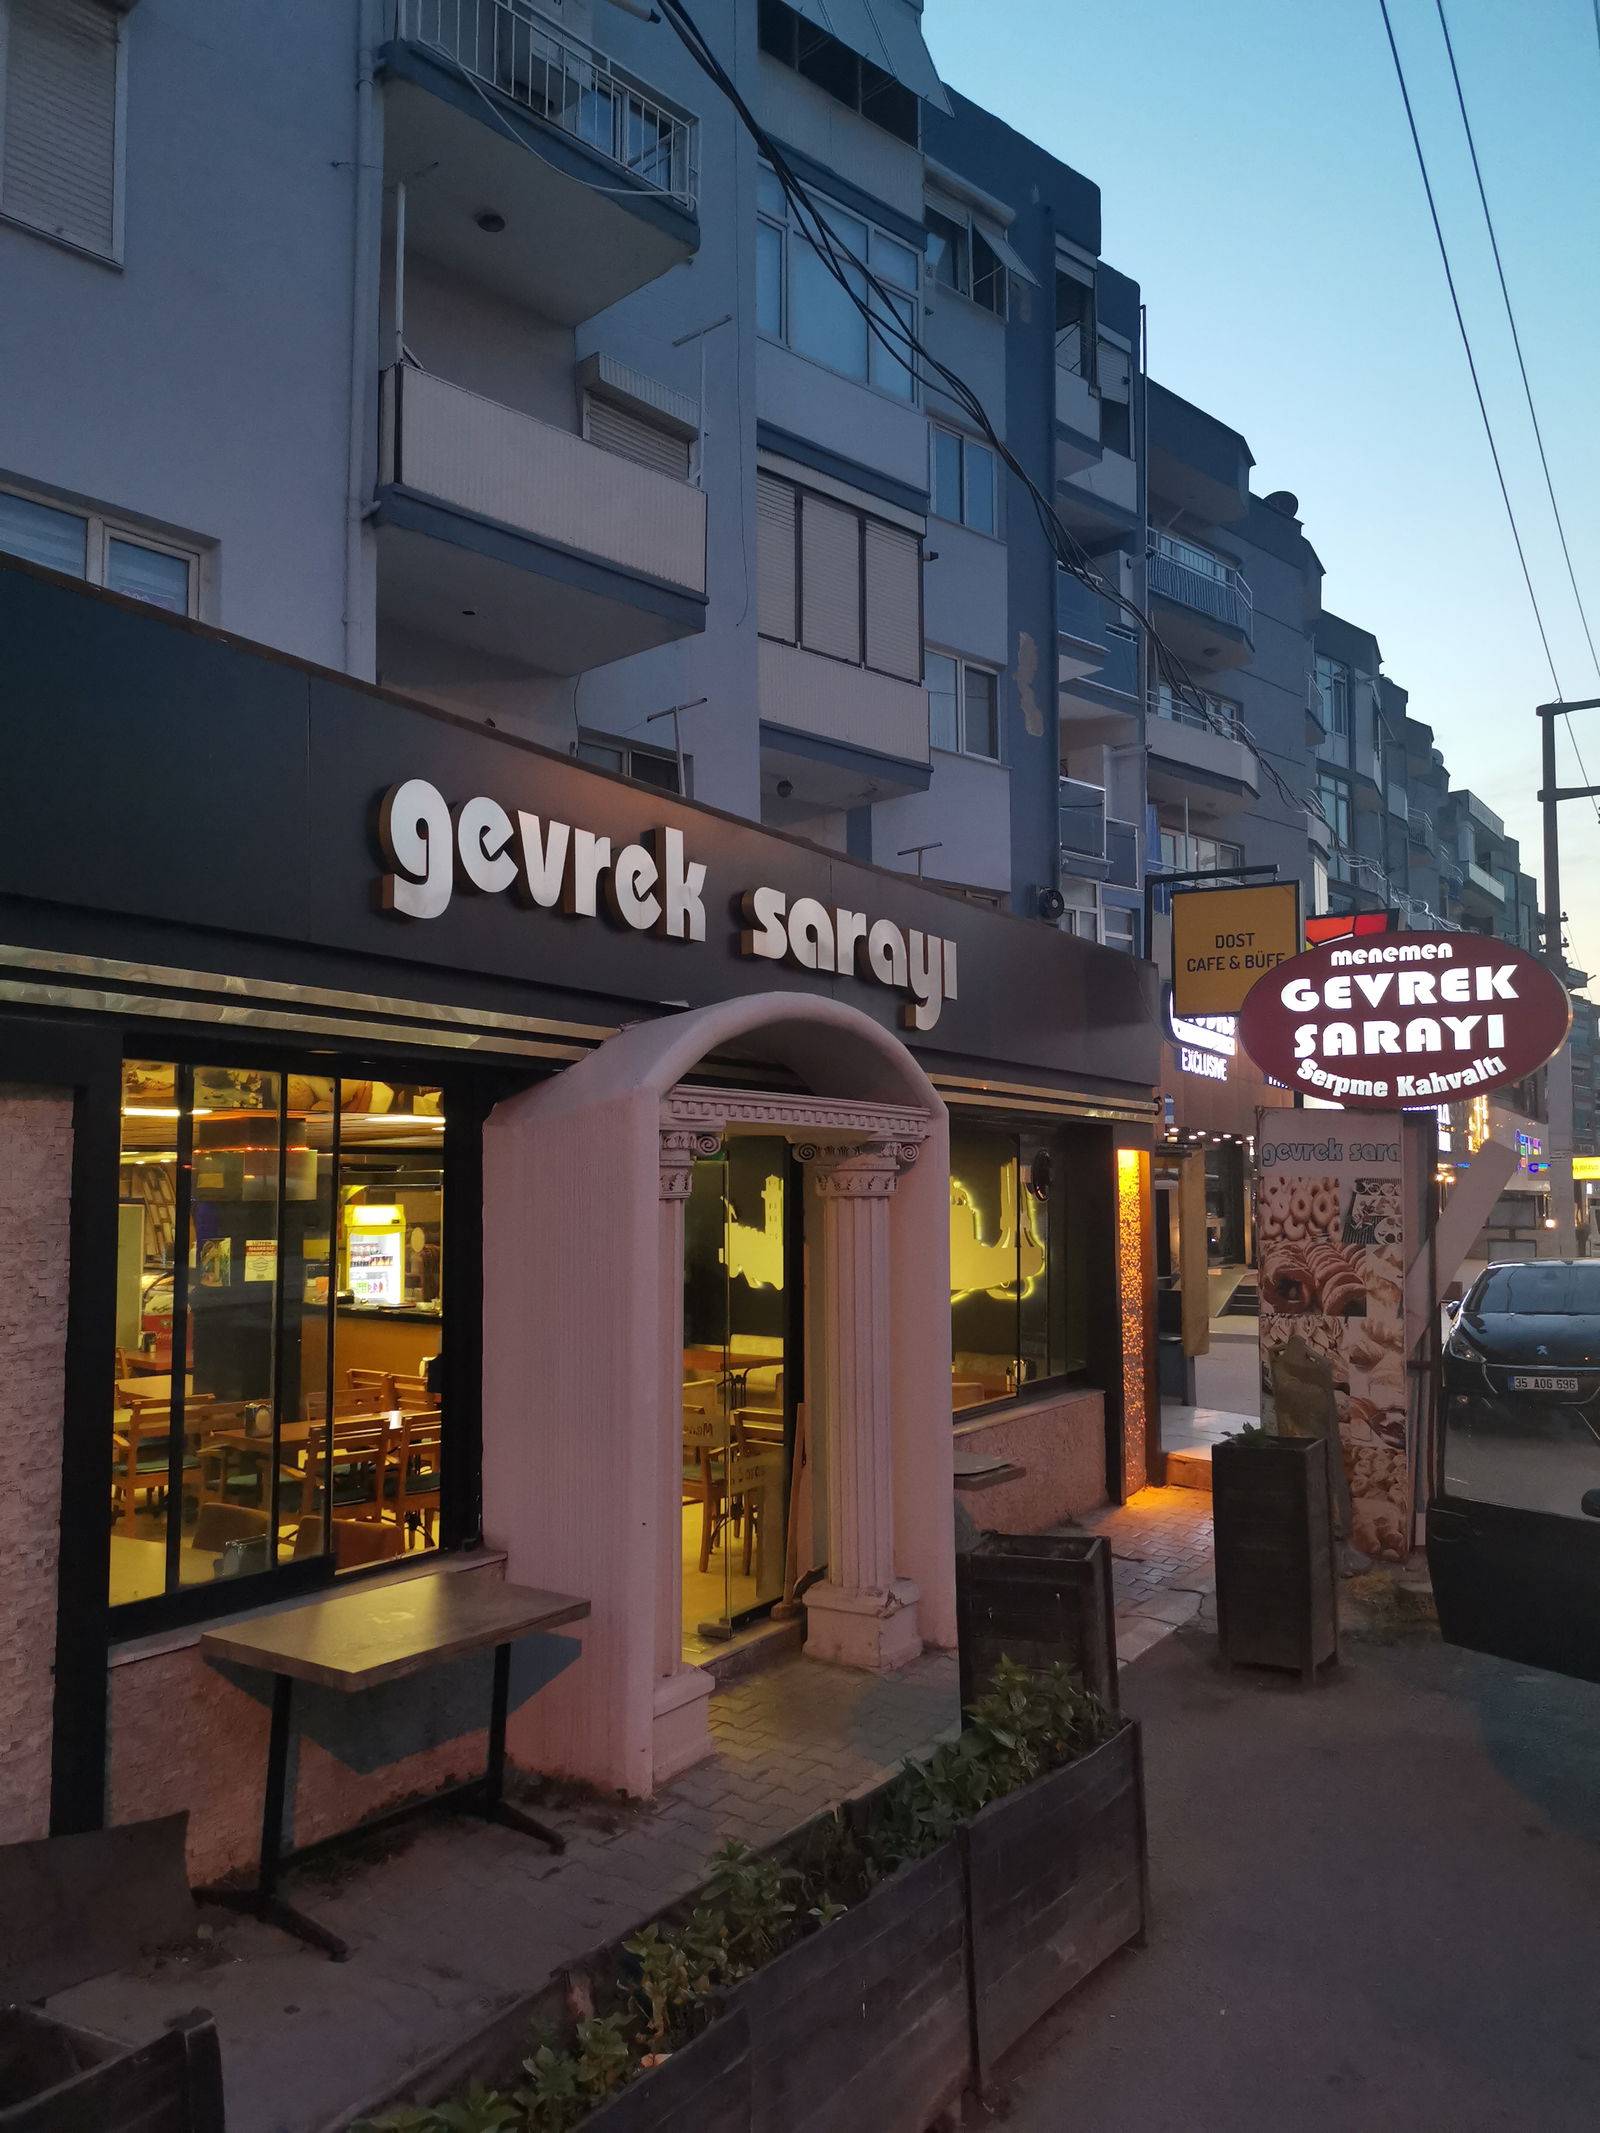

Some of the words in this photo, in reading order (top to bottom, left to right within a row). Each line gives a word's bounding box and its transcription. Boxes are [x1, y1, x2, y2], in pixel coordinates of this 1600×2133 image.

[386, 778, 708, 942] gevrek
[745, 886, 958, 1031] sarayı
[1215, 932, 1255, 949] DOST
[1330, 942, 1454, 967] menemen
[1186, 956, 1226, 973] CAFE
[1229, 955, 1241, 970] &
[1280, 964, 1520, 1012] GEVREK
[1293, 1014, 1505, 1059] SARAYI
[1181, 1046, 1228, 1082] EXCLUSIVE
[1296, 1057, 1389, 1098] Serpme
[1396, 1056, 1508, 1098] Kahvaltı
[1261, 1137, 1343, 1168] gevrek
[1515, 1377, 1528, 1388] 35
